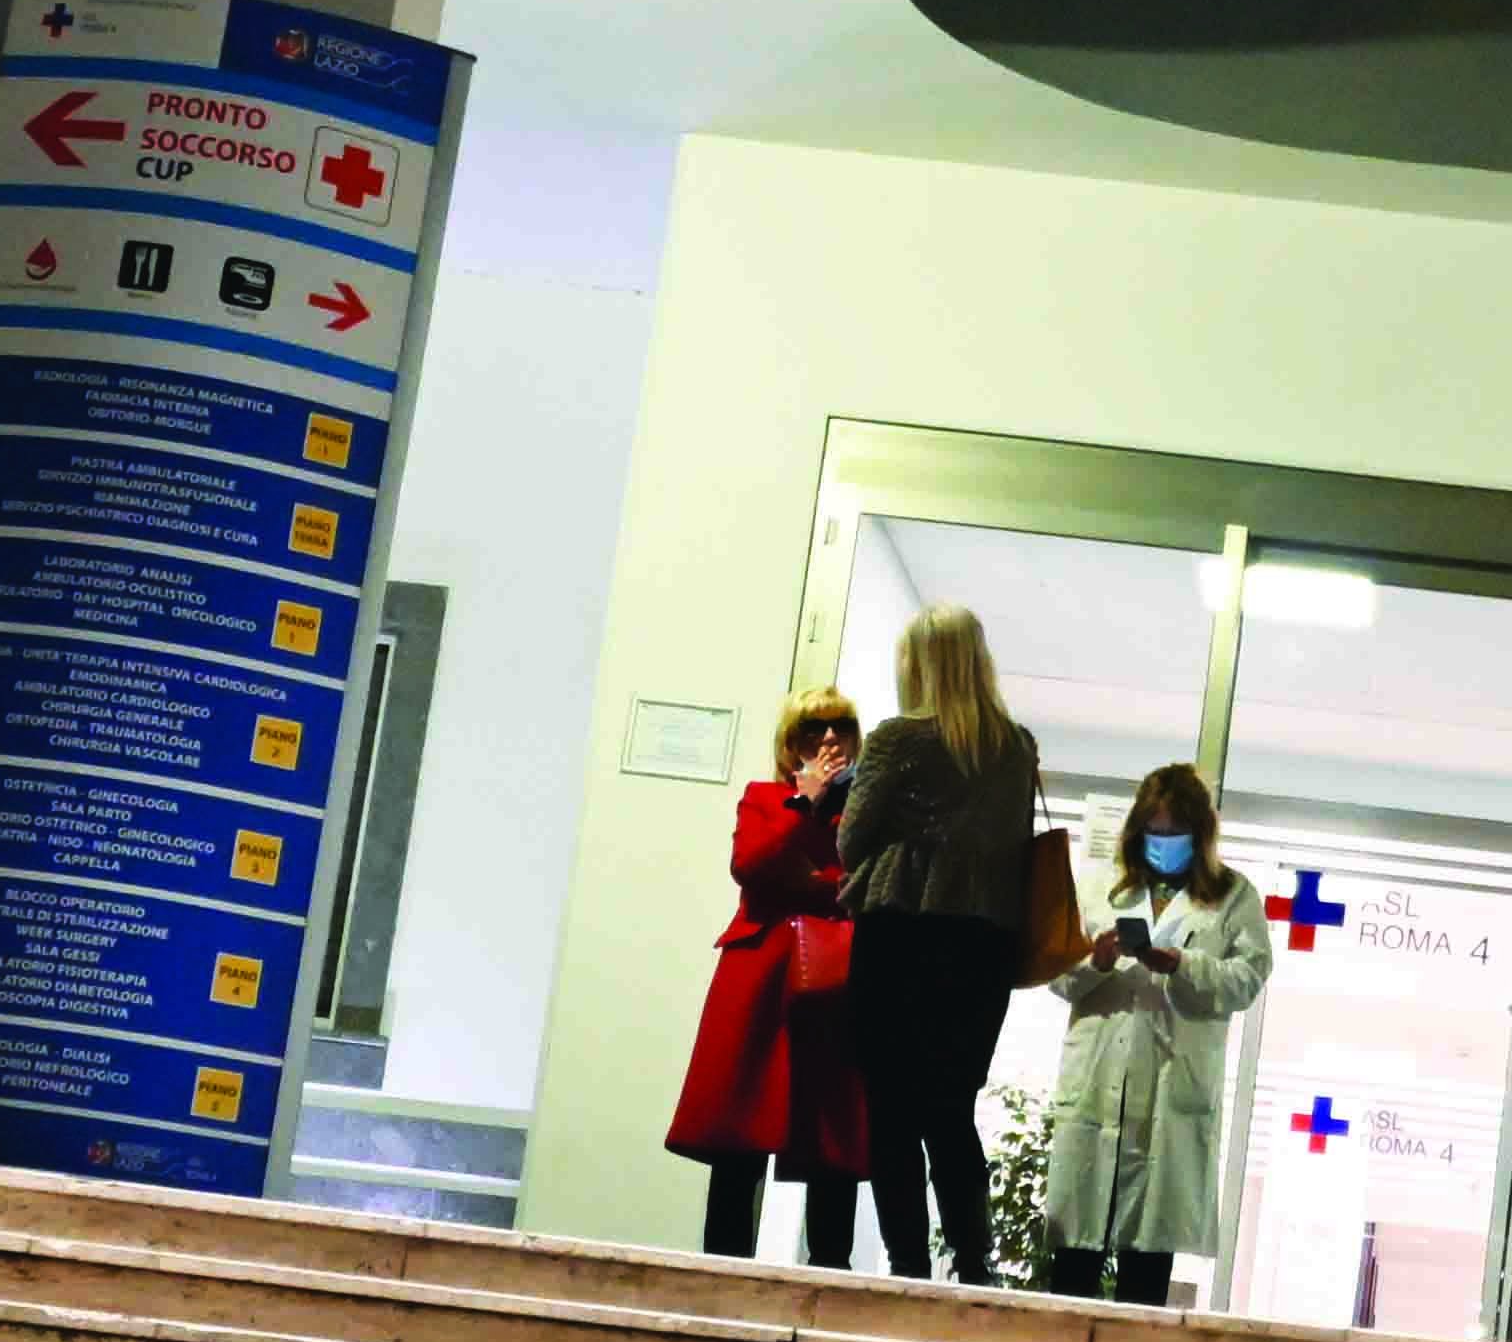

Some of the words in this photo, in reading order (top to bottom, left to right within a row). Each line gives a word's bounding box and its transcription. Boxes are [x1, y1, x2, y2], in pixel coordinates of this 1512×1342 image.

[317, 35, 382, 66] REGIONE
[314, 53, 360, 77] LAZIO
[146, 91, 268, 131] PRONTO
[140, 128, 297, 174] SOCCORSO
[136, 156, 194, 182] CUP
[85, 389, 150, 407] FARMACIA
[153, 399, 209, 416] INTERNA
[119, 377, 195, 397] RISONANZA
[197, 389, 273, 414] MAGNETICA
[71, 455, 123, 470] PIASTRA
[126, 462, 236, 491] AMBULATORIALE
[93, 491, 191, 516] RIANIMAZIONE
[56, 504, 143, 524] PSICHIATRICO
[147, 515, 213, 536] DIAGNOSI
[224, 528, 258, 547] CURA
[296, 516, 331, 533] PIANO
[295, 531, 328, 547] TERRA
[44, 555, 134, 576] LABORATORIO
[139, 566, 192, 587] ANALISI
[32, 570, 125, 591] AMBULATORIO
[128, 582, 207, 605] OCULISTICO
[73, 591, 99, 605] DAY
[101, 594, 165, 614] HOSPITAL
[171, 606, 256, 632] ONCOLOGICO
[73, 608, 137, 627] MEDICINA
[278, 612, 315, 630] PIANO
[65, 652, 118, 670] TERAPIA
[122, 659, 191, 683] INTENSIVA
[193, 672, 287, 701] CARDIOLOGICA
[69, 669, 167, 694] EMODINAMICA
[14, 680, 108, 702] AMBULATORIO
[110, 692, 210, 718] CARDIOLOGICO
[41, 700, 113, 719] CHIRURGIA
[115, 710, 185, 731] GENERALE
[5, 712, 78, 731] ORTOPEDIA
[89, 723, 201, 751] TRAUMATOLOGIA
[258, 727, 297, 744] PIANO
[49, 735, 120, 755] CHIRURGIA
[124, 745, 201, 768] VASCOLARE
[4, 778, 77, 796] OSTETRICIA
[88, 788, 178, 813] GINECOLOGIA
[51, 800, 84, 815] SALA
[87, 805, 132, 822] PARTO
[34, 816, 108, 835] OSTETRICO
[118, 827, 215, 854] GINECOLOGICO
[48, 833, 83, 849] NIDO
[93, 840, 197, 868] NEONATOLOGIA
[53, 852, 121, 872] CAPPELLA
[239, 844, 277, 860] PIANO
[5, 889, 57, 905] BLOCCO
[59, 896, 145, 919] OPERATORIO
[16, 924, 54, 939] WEEK
[56, 930, 118, 948] SURGERY
[37, 909, 51, 921] DI
[53, 912, 168, 940] STERILIZZAZIONE
[24, 943, 59, 957] SALA
[62, 948, 102, 964] GESSI
[1359, 922, 1451, 955] ROMA
[1470, 936, 1489, 965] 4
[57, 964, 147, 987] FISIOTERAPIA
[219, 965, 257, 982] PIANO
[55, 980, 153, 1006] DIABETOLOGIA
[58, 997, 129, 1019] DIGESTIVA
[62, 1047, 111, 1065] DIALISI
[1, 1074, 93, 1097] PERITONEALE
[34, 1061, 129, 1085] NEFROLOGICO
[199, 1081, 237, 1097] PIANO
[1440, 1143, 1454, 1163] 4
